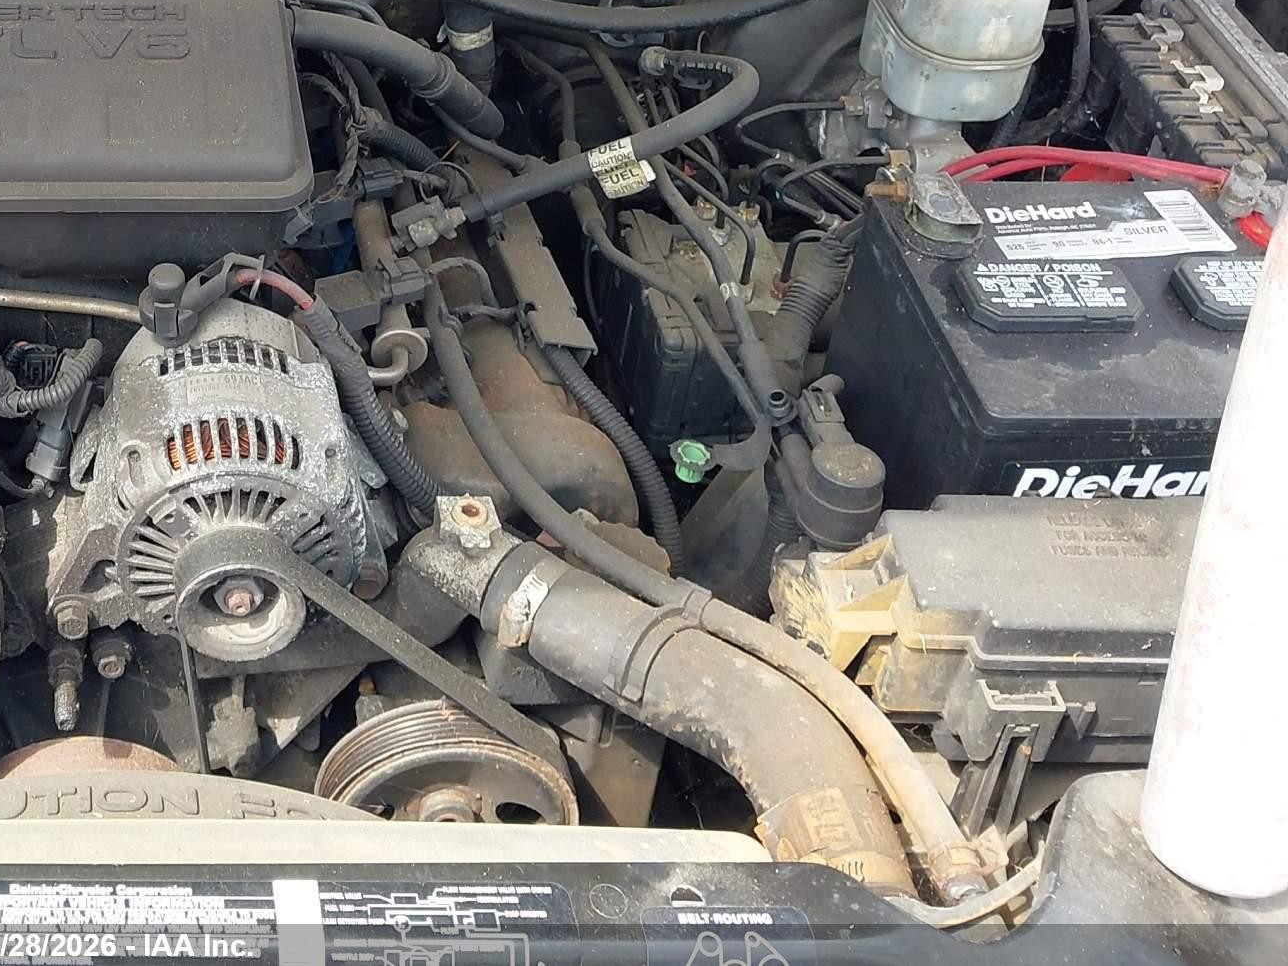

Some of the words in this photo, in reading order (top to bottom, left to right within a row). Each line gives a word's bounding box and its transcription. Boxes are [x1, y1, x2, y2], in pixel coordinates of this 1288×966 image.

[76, 26, 192, 61] V6
[589, 139, 627, 158] FUEL
[592, 151, 632, 169] CAUTION
[601, 167, 640, 185] FUEL
[984, 202, 1097, 224] DieHard
[1124, 225, 1168, 235] SILVER
[988, 264, 1042, 272] DANGER
[1055, 263, 1102, 272] POISON
[1012, 464, 1211, 499] DieHar
[713, 912, 774, 925] ROUTING
